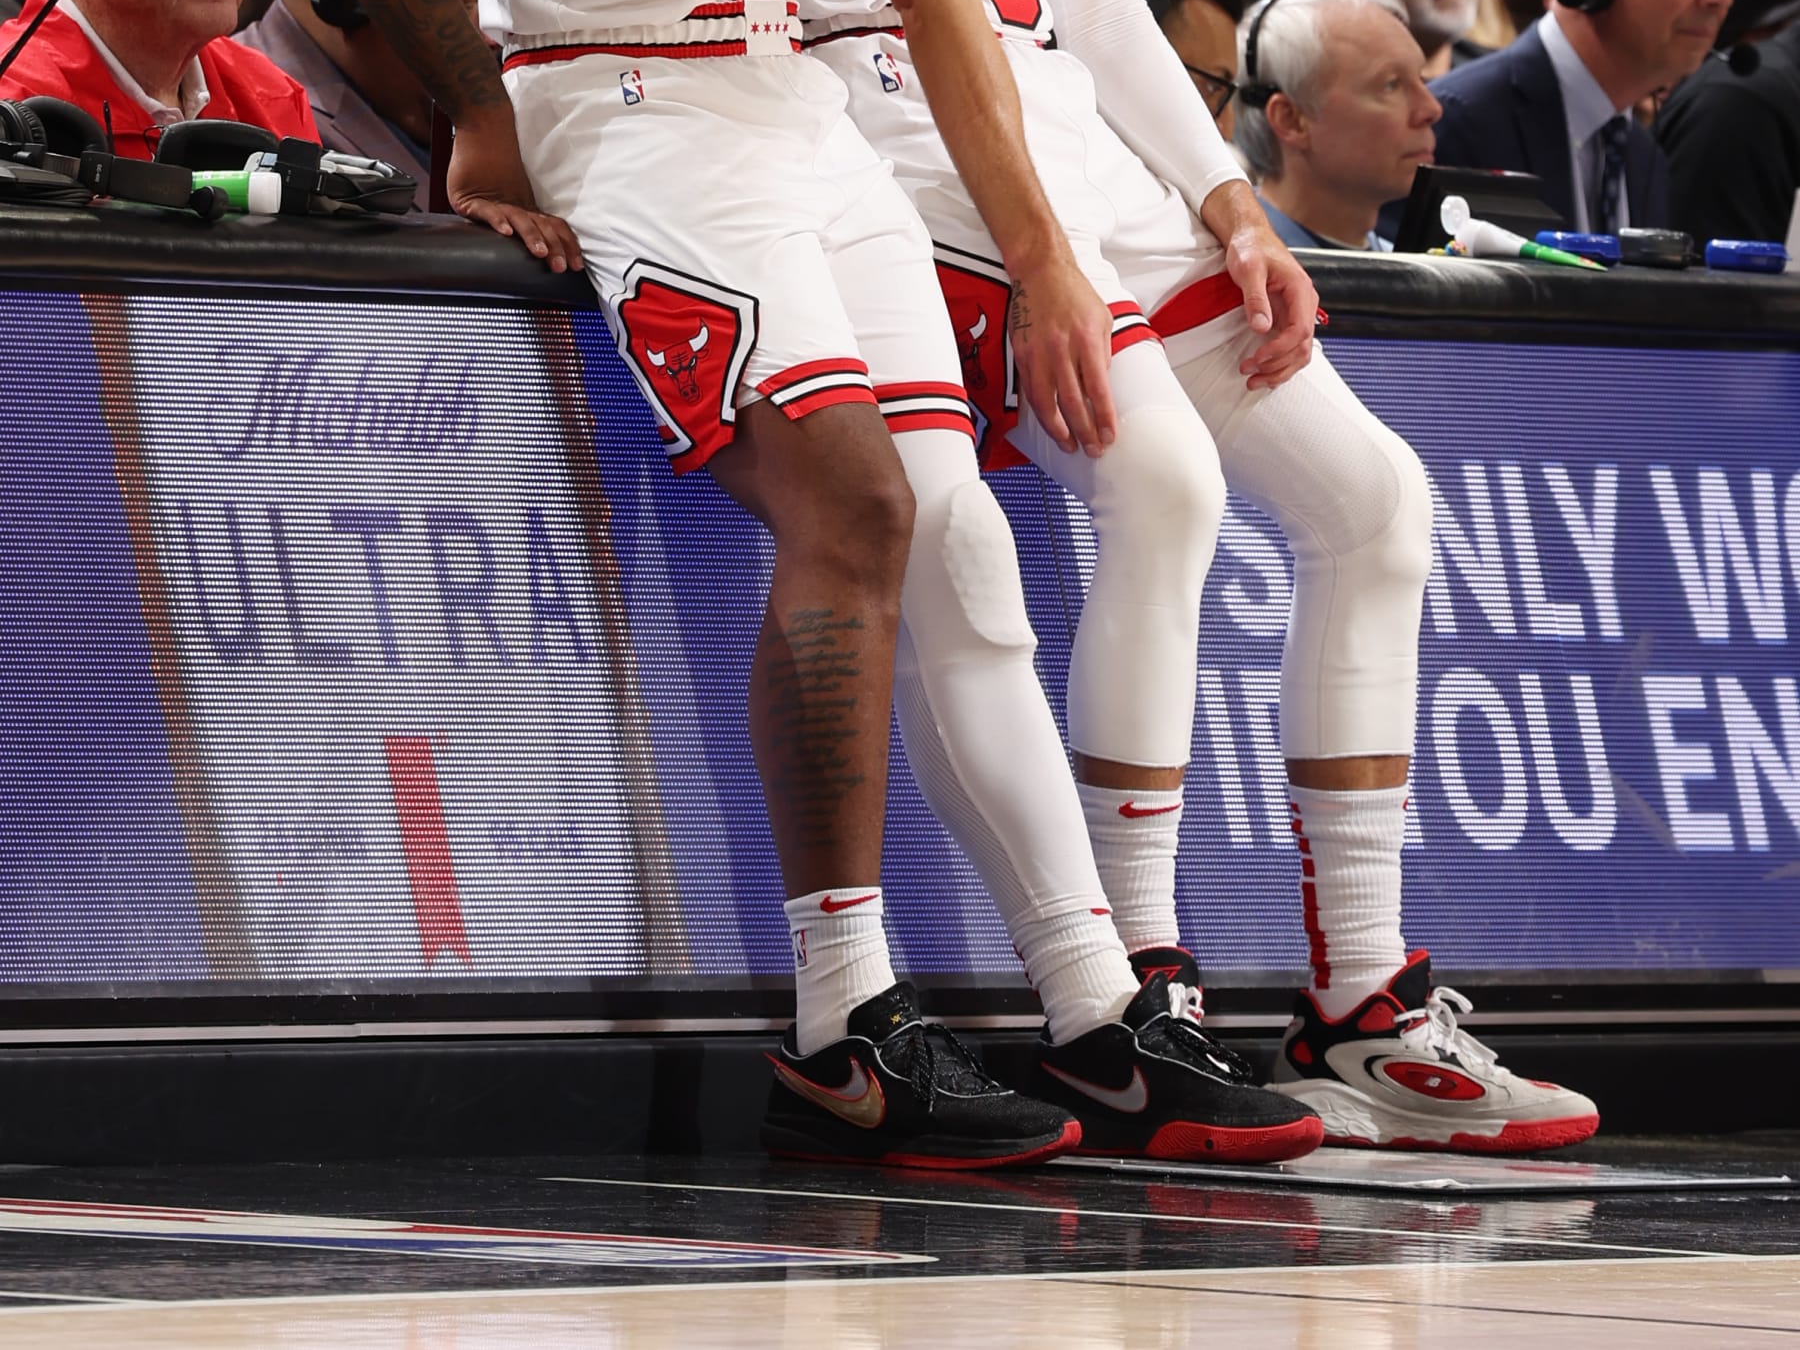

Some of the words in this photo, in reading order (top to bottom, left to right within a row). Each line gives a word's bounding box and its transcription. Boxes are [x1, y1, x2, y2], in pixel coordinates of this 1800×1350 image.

[205, 338, 480, 461] Michelob
[179, 500, 592, 669] ULTRA
[1427, 461, 1624, 642] NLY
[1648, 465, 1800, 643] W
[1403, 666, 1616, 852] OU
